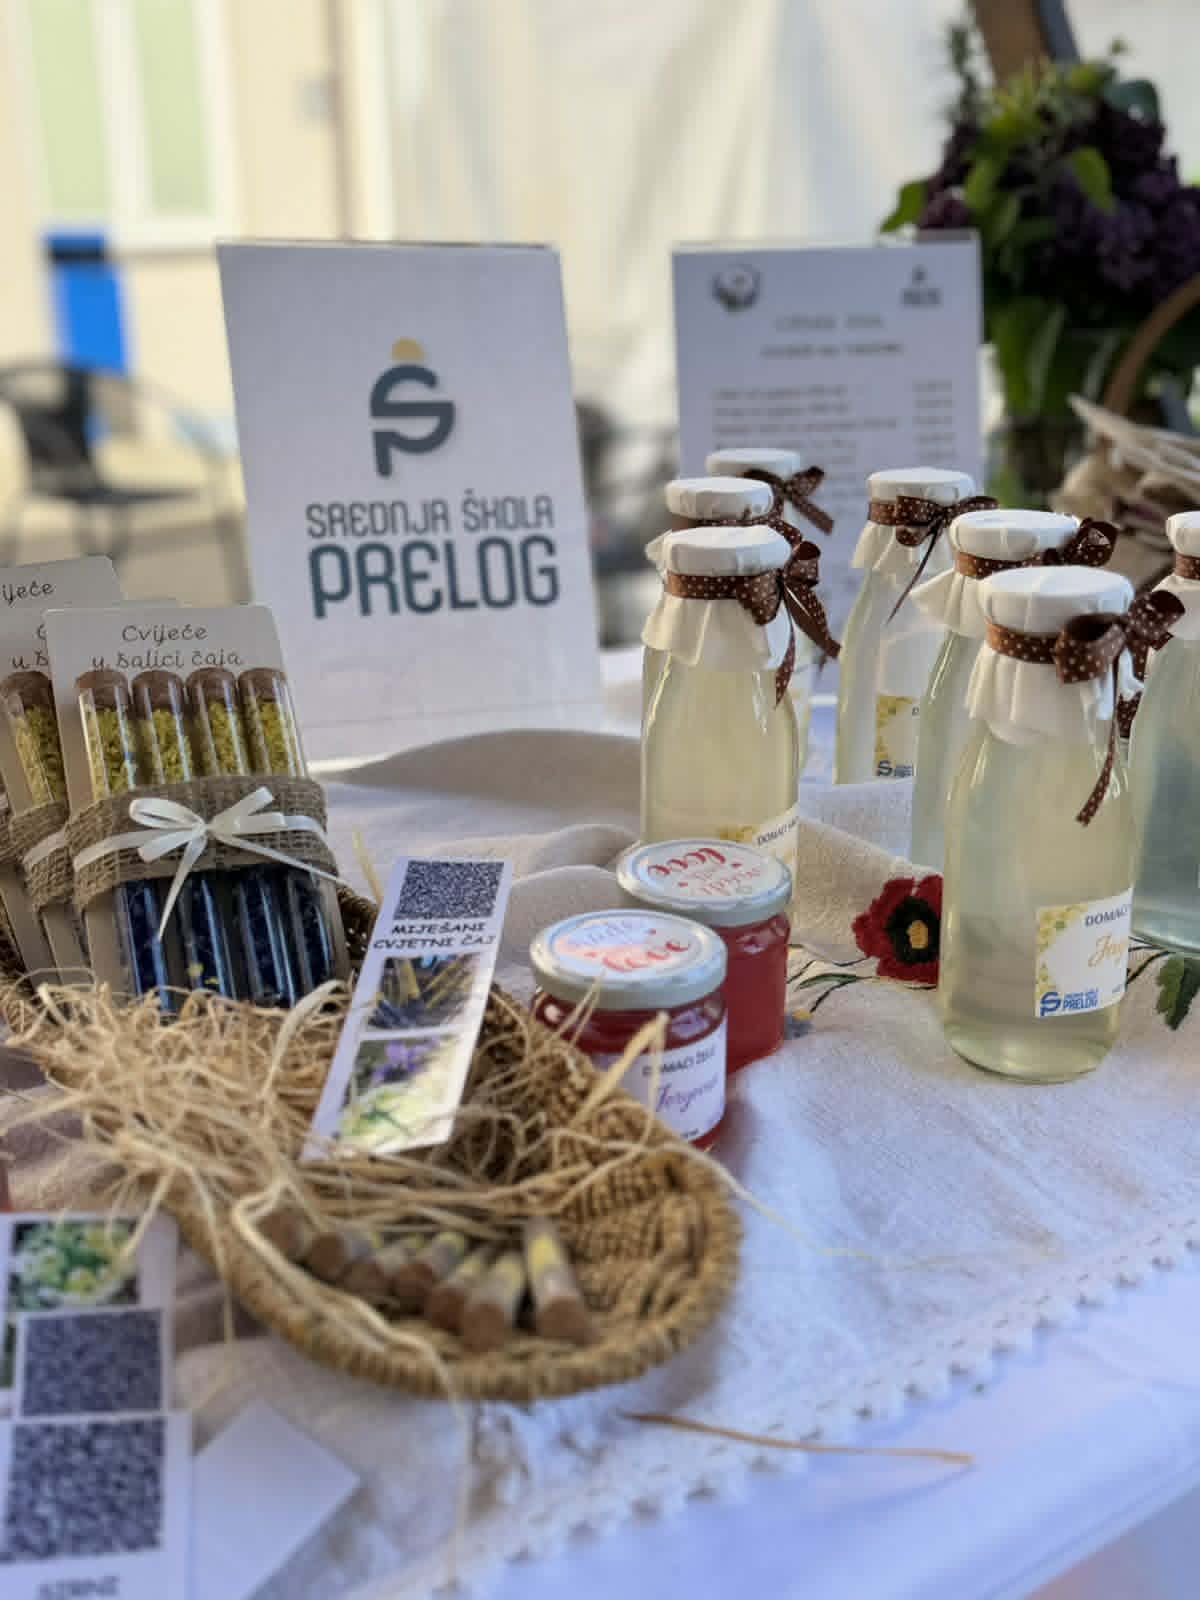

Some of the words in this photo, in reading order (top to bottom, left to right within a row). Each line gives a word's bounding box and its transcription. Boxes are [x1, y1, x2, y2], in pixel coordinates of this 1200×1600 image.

[305, 499, 451, 539] SREDNJA
[462, 489, 555, 532] ŠKOLA
[308, 535, 560, 619] PRELOG
[92, 656, 105, 671] u
[391, 921, 487, 935] MIJEŠANI
[373, 936, 455, 950] CVJETNI
[461, 934, 497, 945] ČAJ
